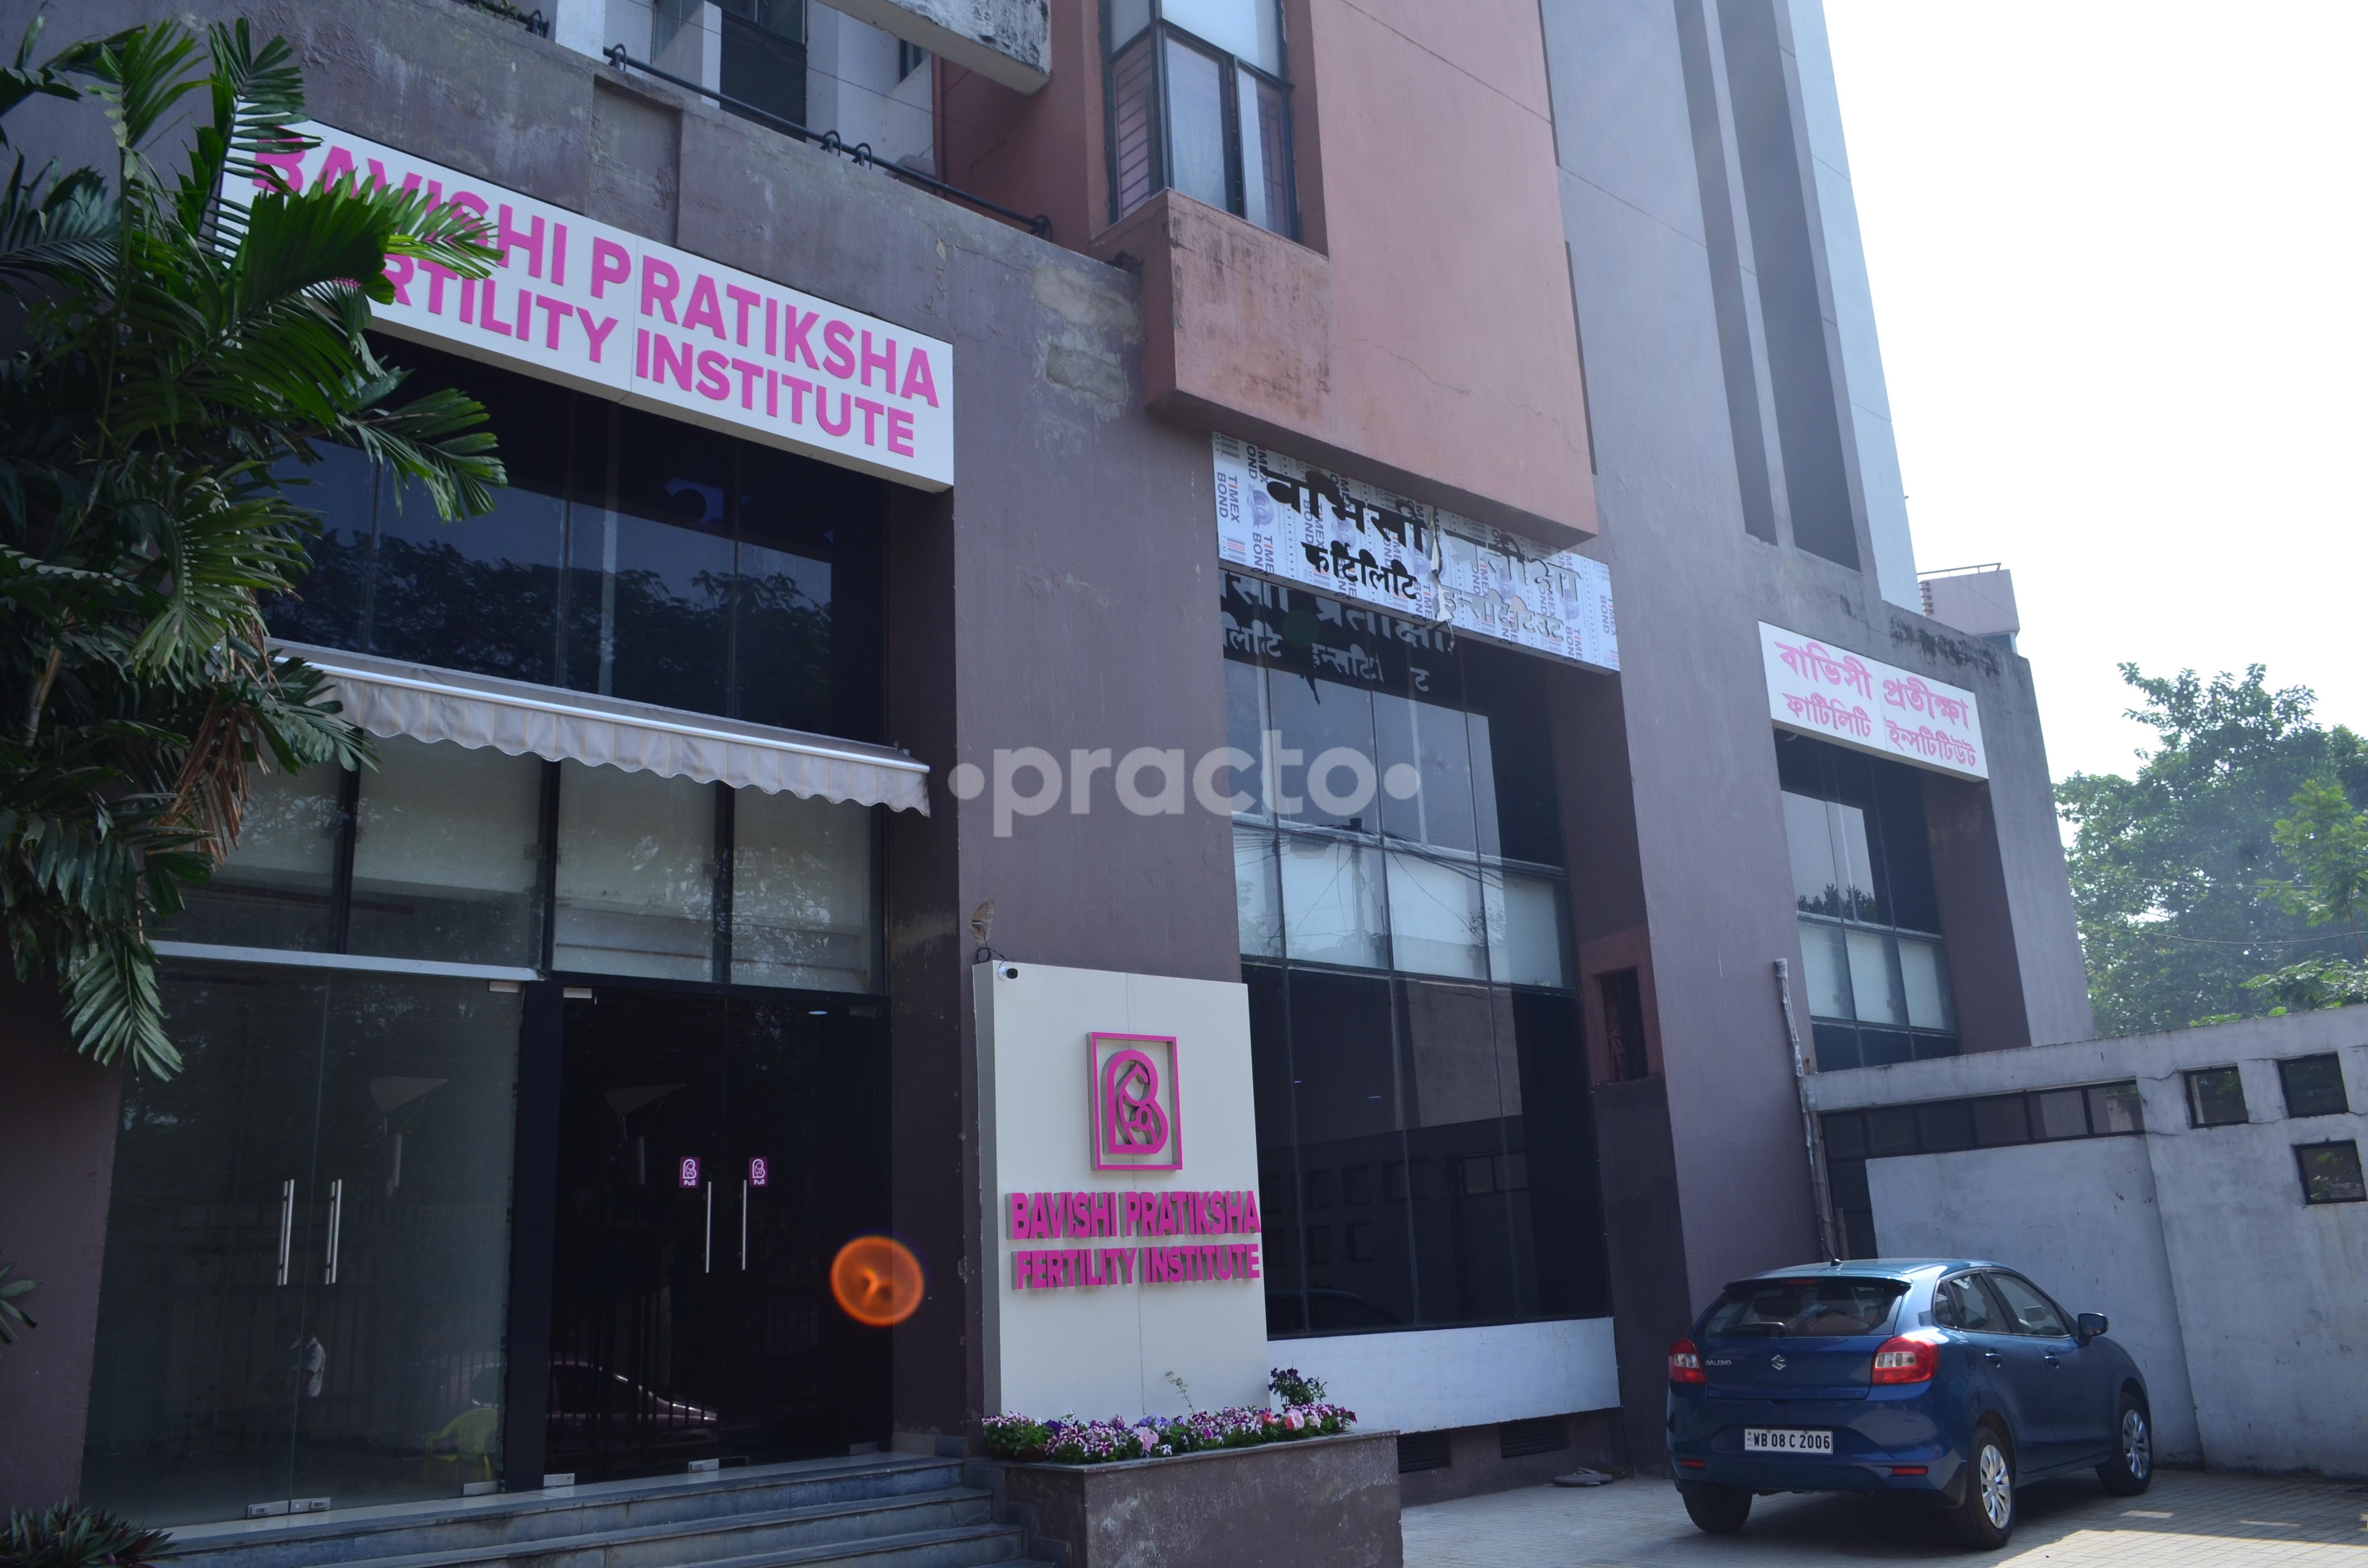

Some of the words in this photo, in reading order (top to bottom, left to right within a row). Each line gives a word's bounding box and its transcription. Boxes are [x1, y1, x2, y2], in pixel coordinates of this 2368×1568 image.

[591, 236, 939, 408] PRATIKSHA
[365, 254, 618, 364] RTILITY
[636, 328, 914, 458] INSTITUTE
[1247, 443, 1258, 479] OND
[1217, 472, 1228, 518] BOND
[1228, 475, 1240, 524] TIMEX
[1600, 595, 1610, 634] BOND
[1883, 676, 1969, 729] প্রতীক্ষা
[1007, 1192, 1117, 1239] BAVISHI
[1122, 1190, 1261, 1237] PRATIKSHA
[1013, 1248, 1137, 1289] FERTILITY
[1141, 1243, 1260, 1283] INSTITUTE
[1753, 1433, 1768, 1447] WB
[1771, 1433, 1786, 1447] 08
[1789, 1434, 1796, 1448] C
[1800, 1434, 1830, 1449] 2006
